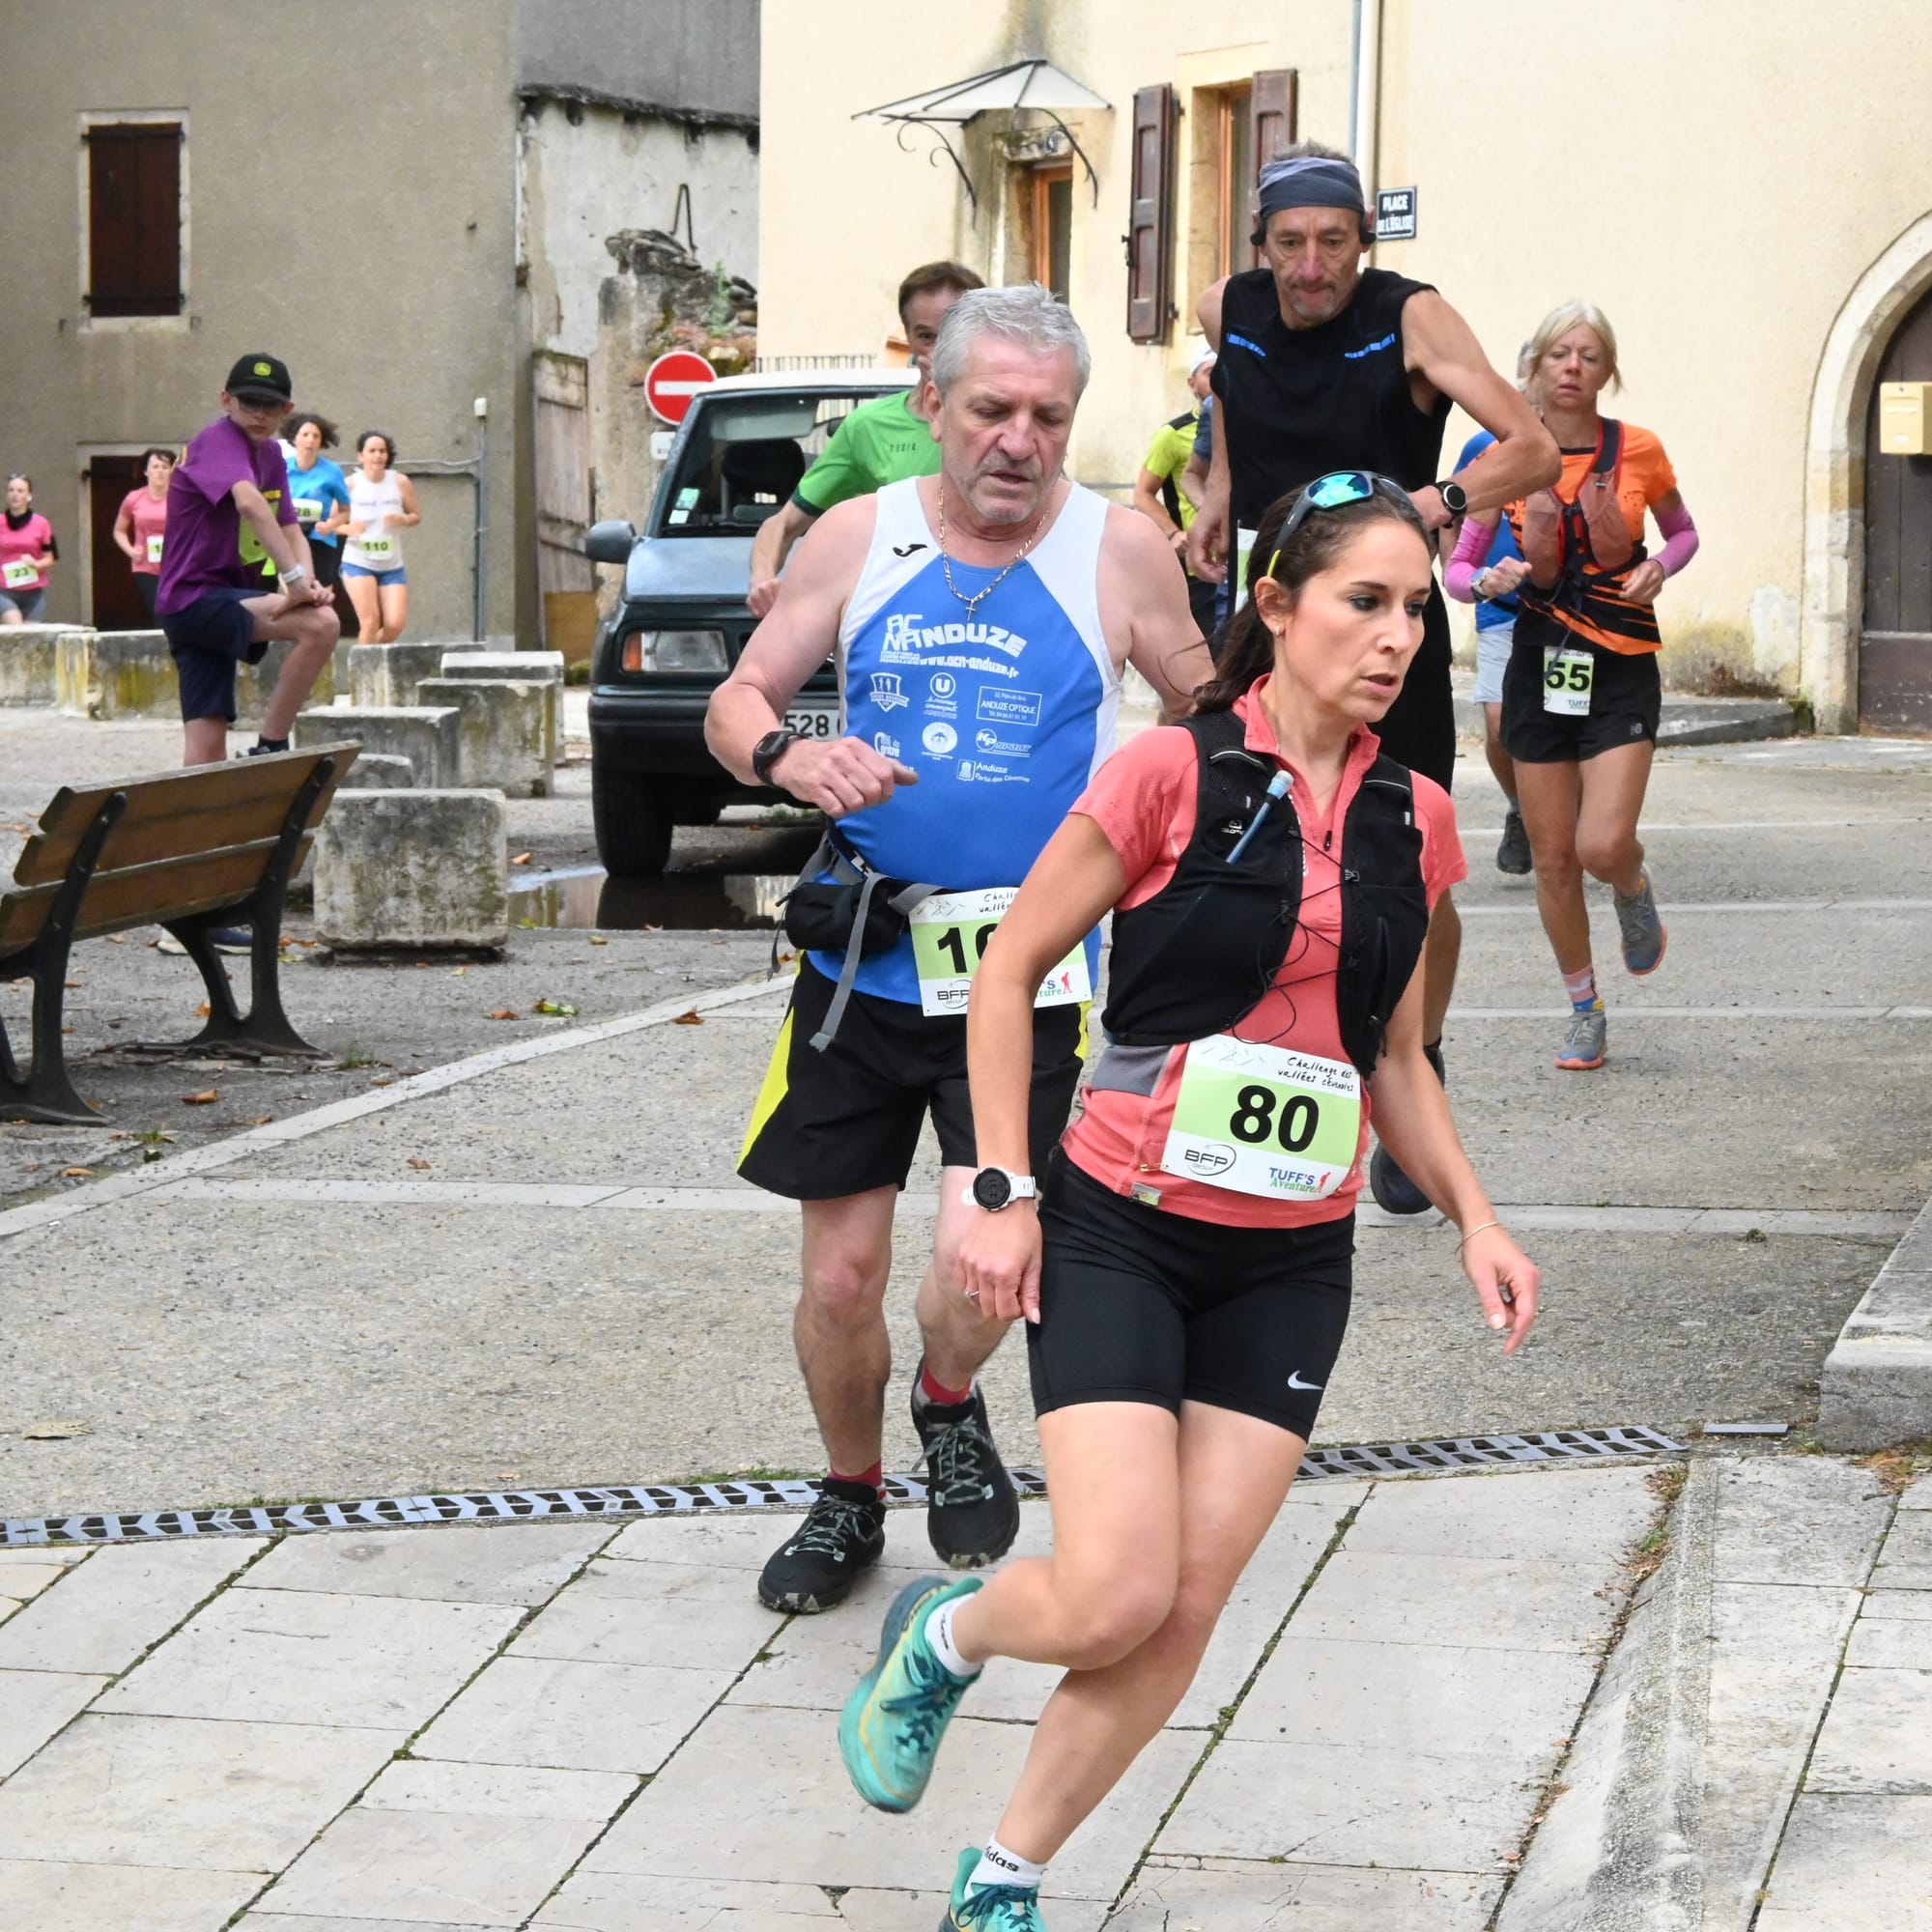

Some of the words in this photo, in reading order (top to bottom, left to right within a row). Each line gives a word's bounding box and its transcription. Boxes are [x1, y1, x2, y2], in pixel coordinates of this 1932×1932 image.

[1382, 194, 1408, 212] PLACE
[364, 541, 388, 552] 110
[14, 567, 29, 578] 23
[1545, 661, 1591, 692] 55
[935, 678, 951, 693] U
[980, 699, 1009, 711] ANDUZE
[1009, 703, 1037, 715] OPTIQUE
[783, 714, 829, 737] 528
[976, 761, 1009, 774] Anduze
[1287, 1056, 1338, 1078] Challenge
[1278, 1069, 1318, 1083] vallées
[1229, 1084, 1320, 1152] 80
[1184, 1149, 1229, 1167] BFP
[1268, 1166, 1316, 1185] TUFF'S
[1269, 1177, 1316, 1193] Aventure
